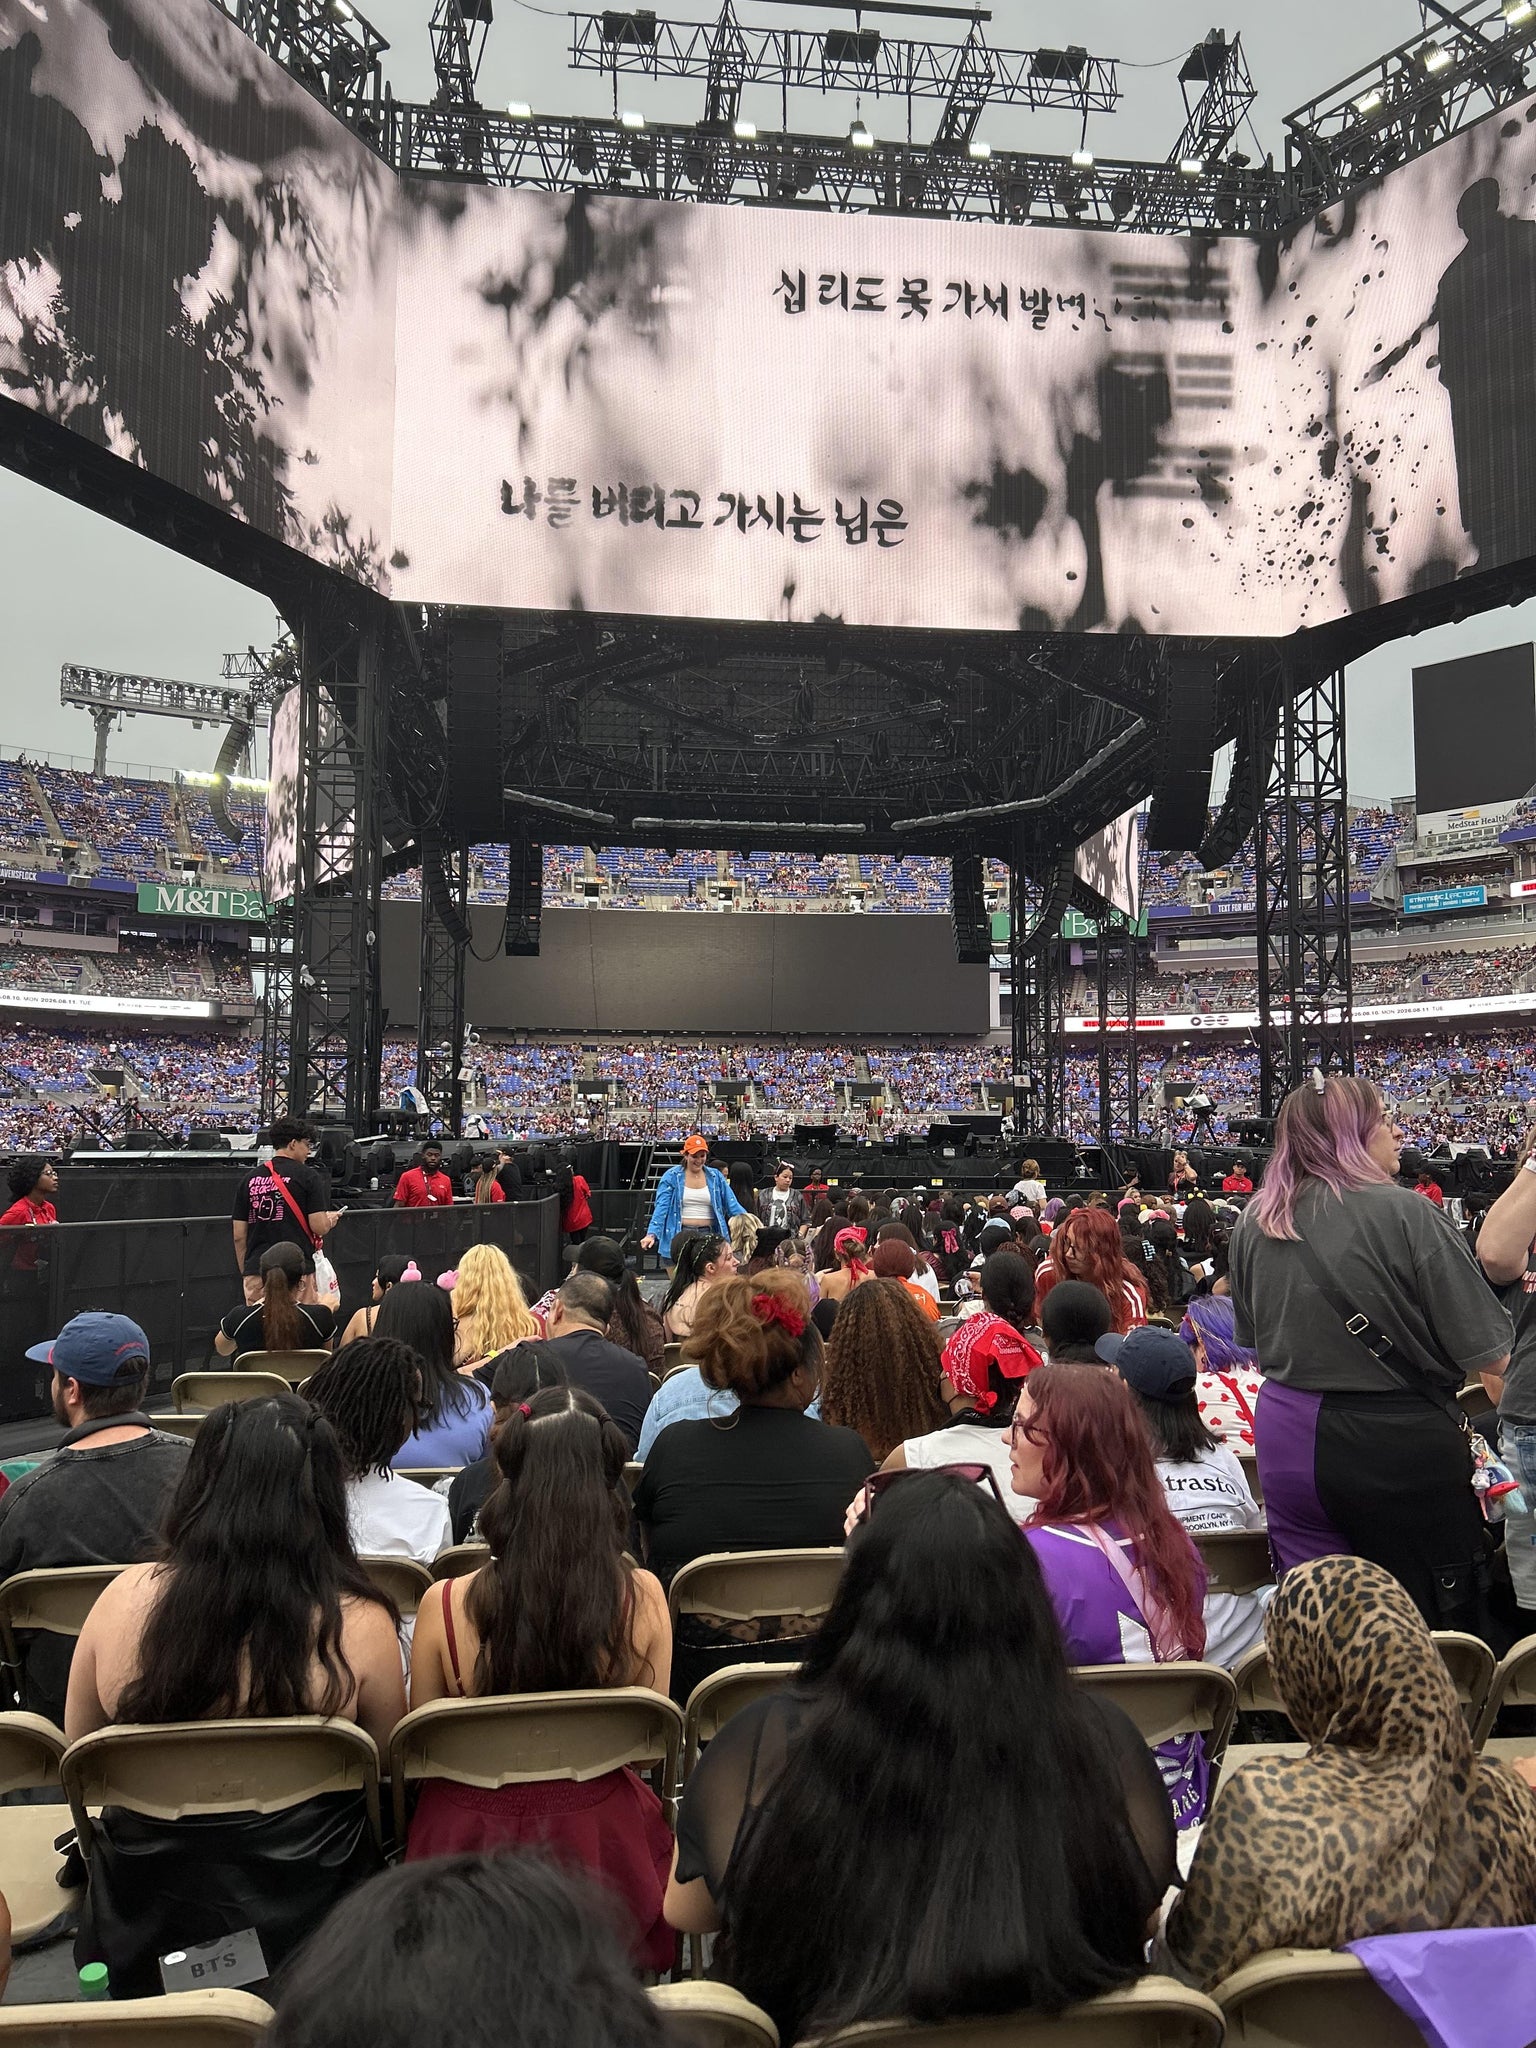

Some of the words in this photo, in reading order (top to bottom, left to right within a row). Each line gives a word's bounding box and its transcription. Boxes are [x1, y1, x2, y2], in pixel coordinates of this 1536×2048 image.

[501, 475, 581, 529] 나를
[593, 481, 705, 531] 버리고
[713, 491, 826, 543] 가시는
[835, 496, 909, 548] 님은
[1448, 820, 1480, 830] MedStar
[1481, 815, 1508, 825] Health
[0, 868, 37, 881] AVENSFLOCK
[155, 886, 228, 916] M&T
[229, 892, 267, 919] Ba
[1449, 890, 1480, 900] FACTORY
[1217, 904, 1231, 913] TEXT
[1232, 903, 1242, 912] FOR
[1243, 902, 1256, 911] HELP
[1165, 1475, 1237, 1496] trasto
[191, 1953, 237, 1978] BTS
